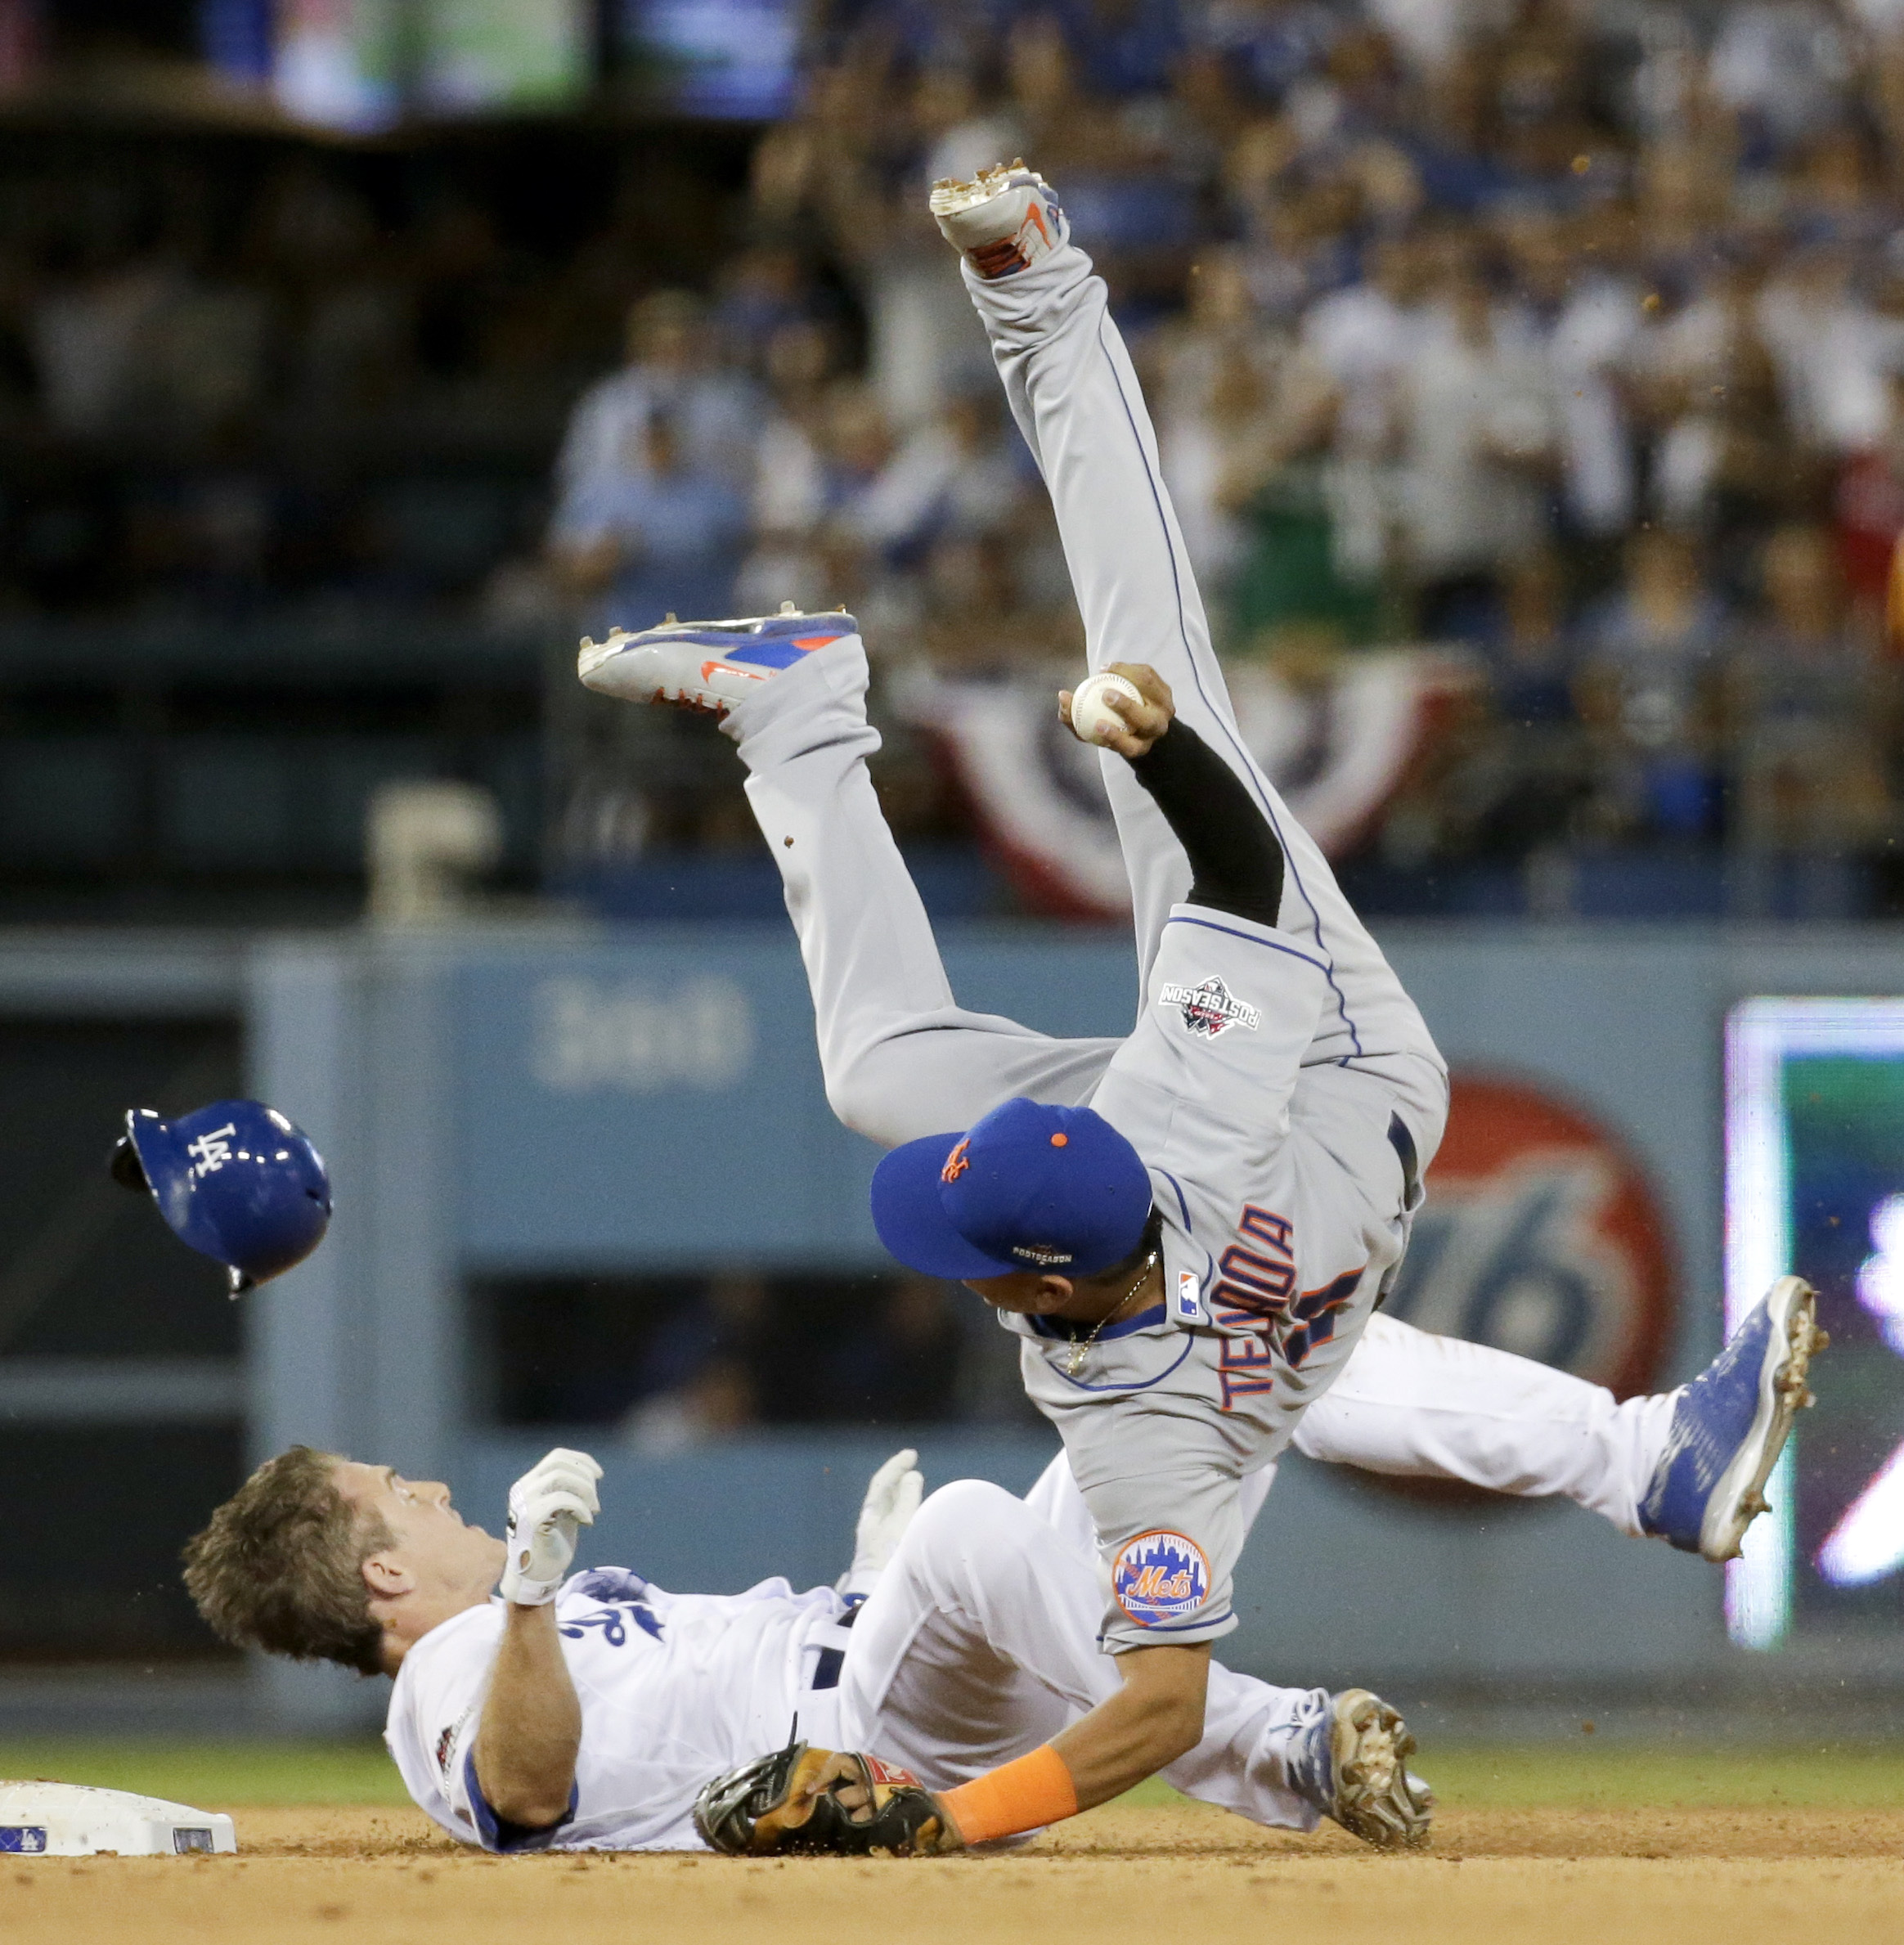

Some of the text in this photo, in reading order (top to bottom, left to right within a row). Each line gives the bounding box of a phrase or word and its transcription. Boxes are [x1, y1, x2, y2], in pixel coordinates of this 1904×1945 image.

[1161, 986, 1260, 1029] POSTSEASON
[187, 1122, 236, 1178] LA
[1125, 1565, 1193, 1598] Mets
